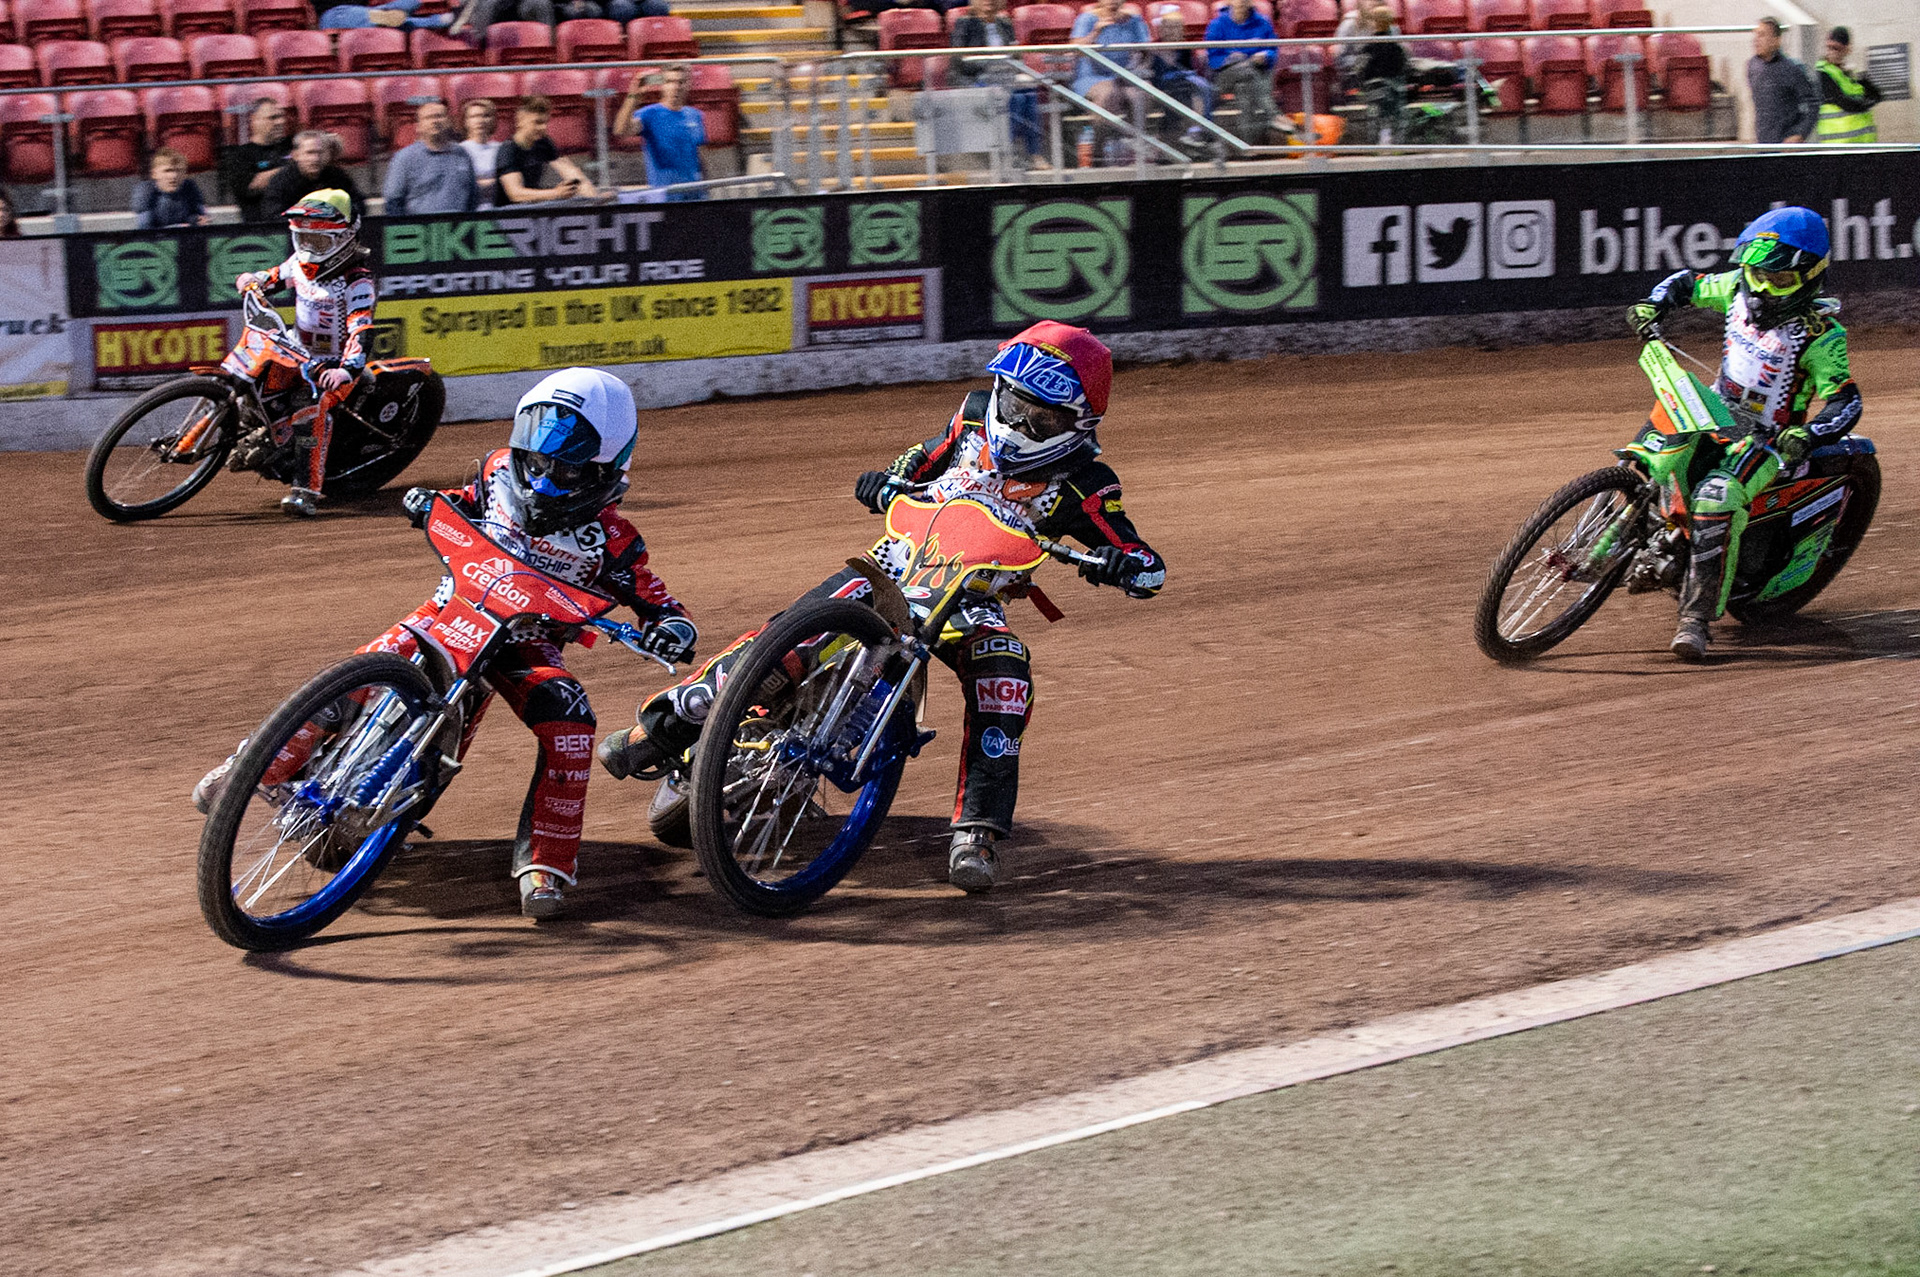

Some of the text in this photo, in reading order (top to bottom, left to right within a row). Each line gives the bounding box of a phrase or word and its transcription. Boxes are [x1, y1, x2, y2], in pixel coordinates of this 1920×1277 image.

[384, 211, 665, 265] BIKERIGHT
[546, 263, 631, 286] YOUR
[638, 258, 705, 283] RIDE
[420, 287, 784, 340] Sprayed in the UK since 1982
[811, 282, 922, 322] HYCOTE
[101, 325, 224, 369] HYCOTE
[530, 536, 579, 562] YOUTH
[579, 525, 601, 546] 5
[462, 562, 530, 608] Crendon
[434, 623, 480, 648] PERRY
[450, 616, 490, 642] MAX
[976, 638, 1023, 655] JCB
[978, 681, 1027, 704] NGK
